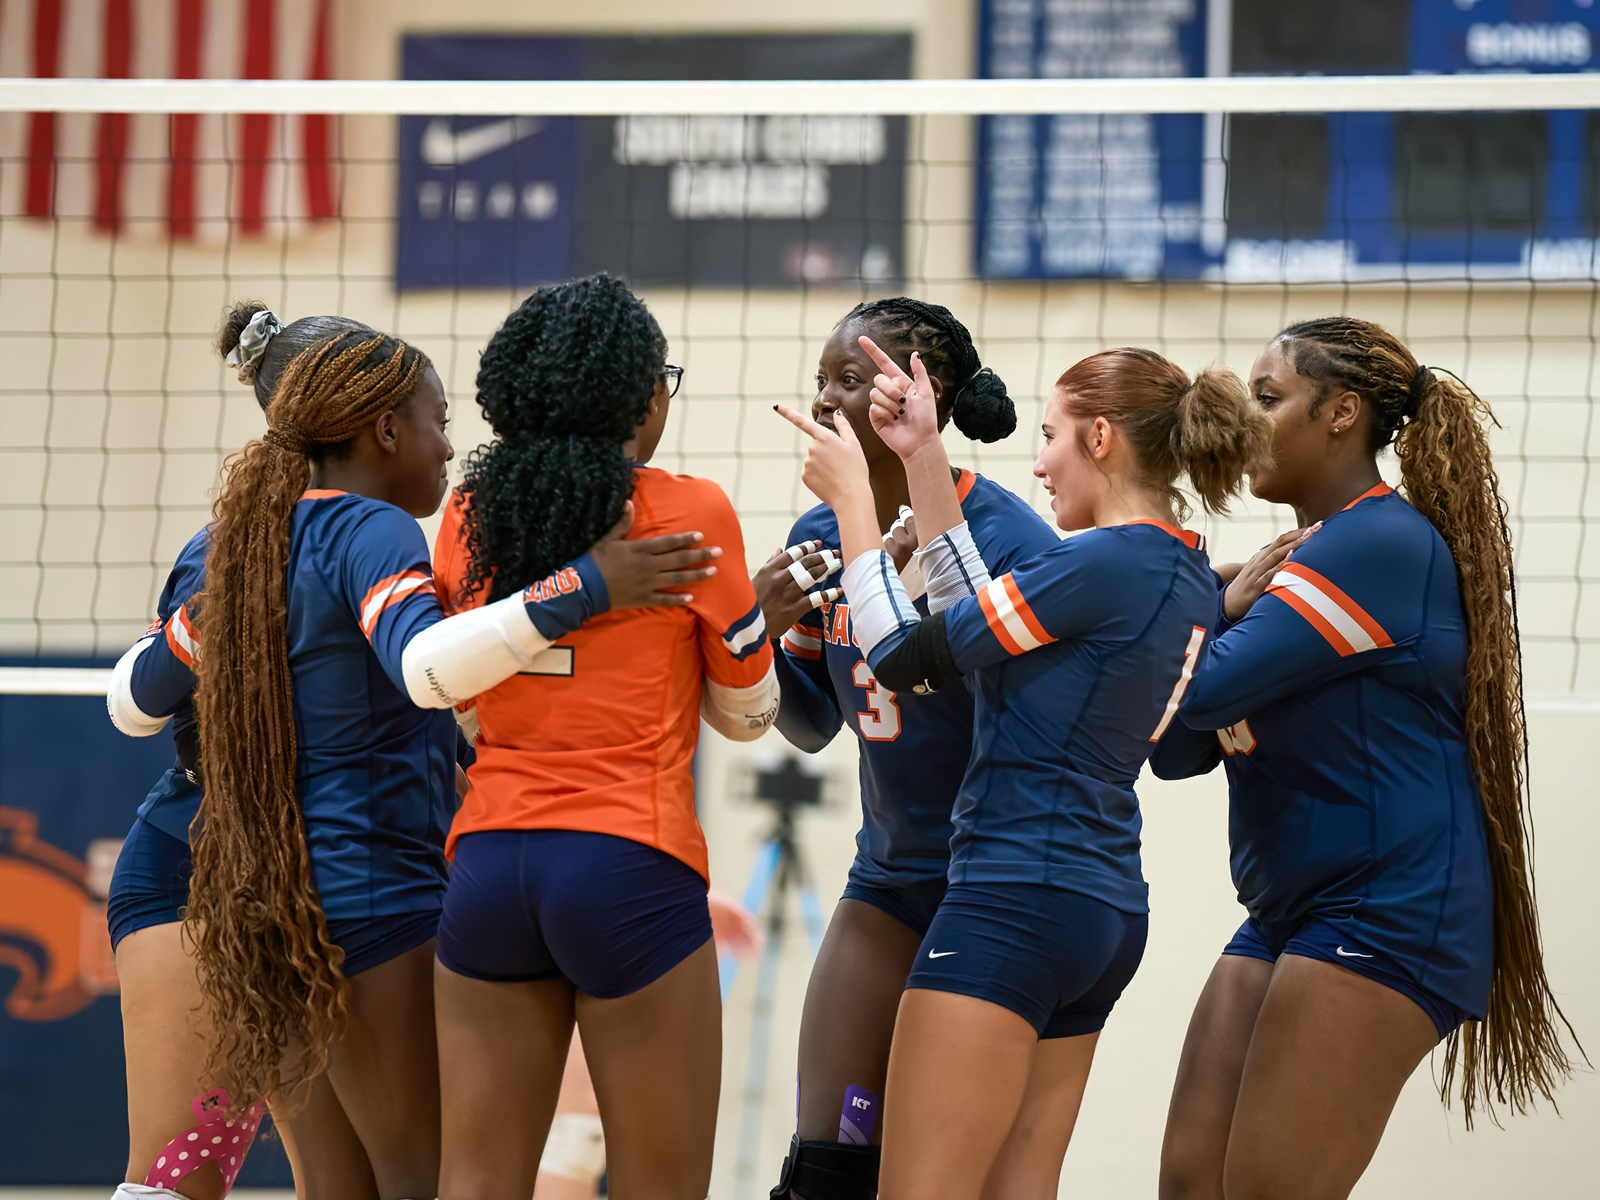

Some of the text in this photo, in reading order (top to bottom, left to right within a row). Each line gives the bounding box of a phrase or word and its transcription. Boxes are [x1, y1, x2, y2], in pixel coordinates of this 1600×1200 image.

[851, 660, 902, 742] 3
[1149, 625, 1207, 743] 1
[852, 1096, 871, 1110] KT
